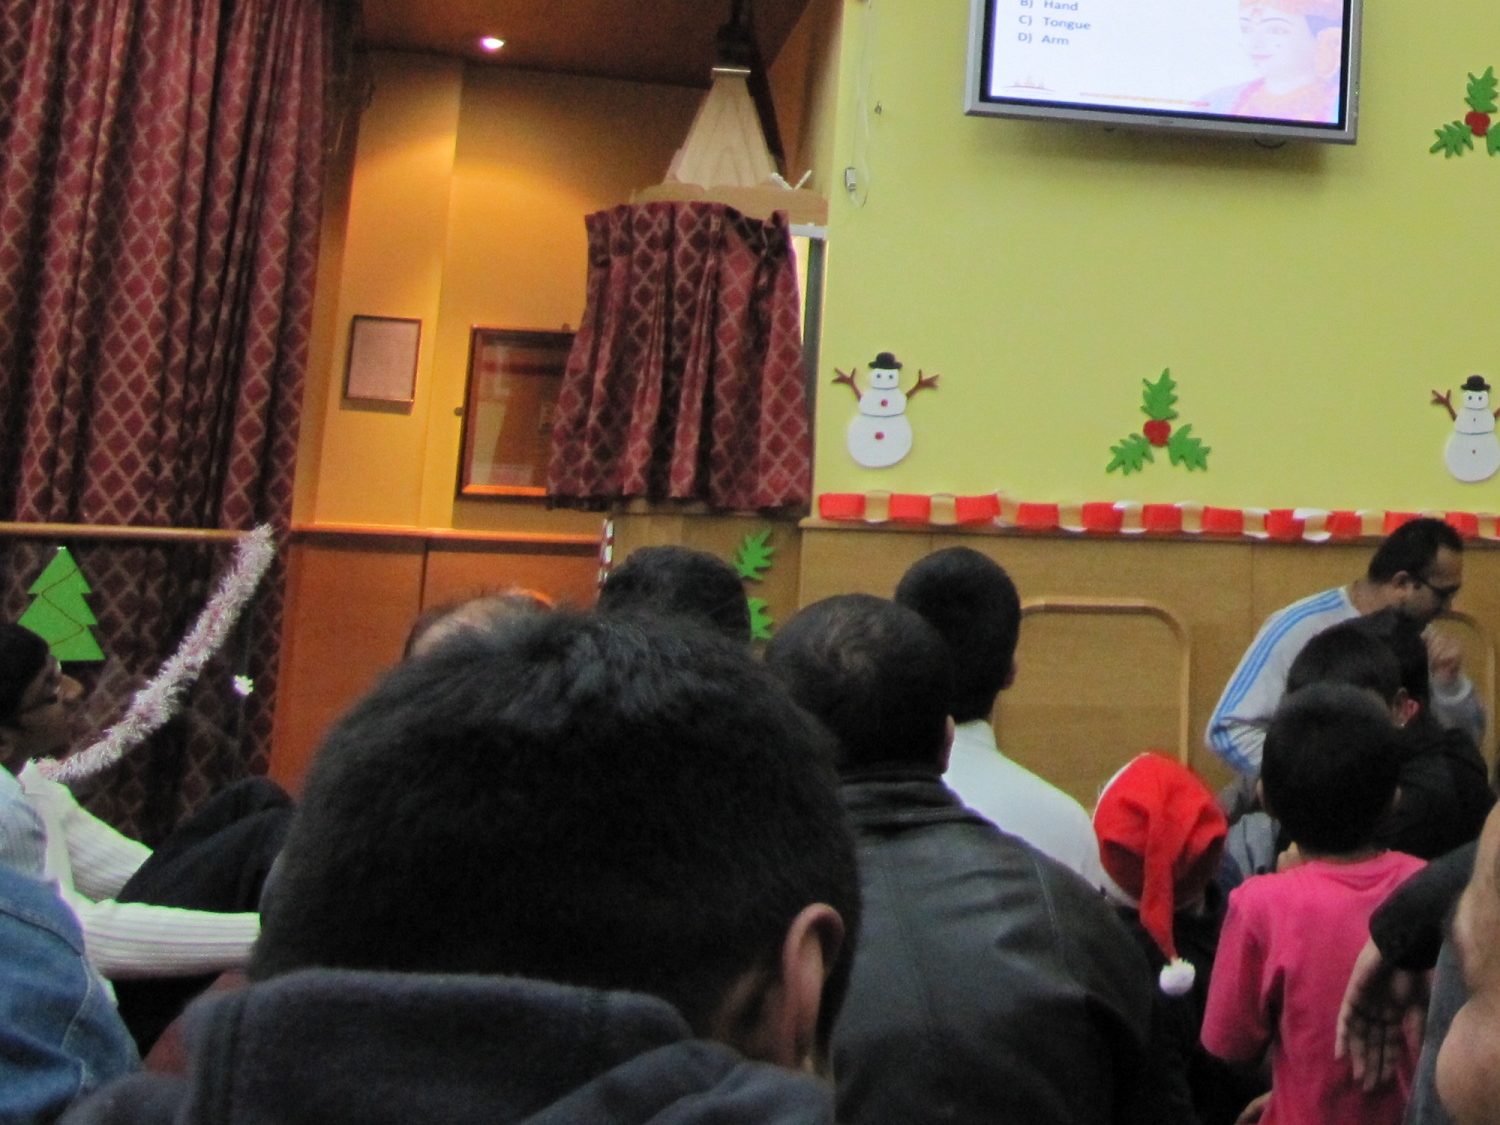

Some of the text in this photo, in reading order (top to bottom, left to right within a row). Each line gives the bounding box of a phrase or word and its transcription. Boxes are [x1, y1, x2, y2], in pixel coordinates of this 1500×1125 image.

[1043, 0, 1079, 11] Hand
[1018, 14, 1092, 31] C) Tongue
[1017, 32, 1070, 46] D) Arm
